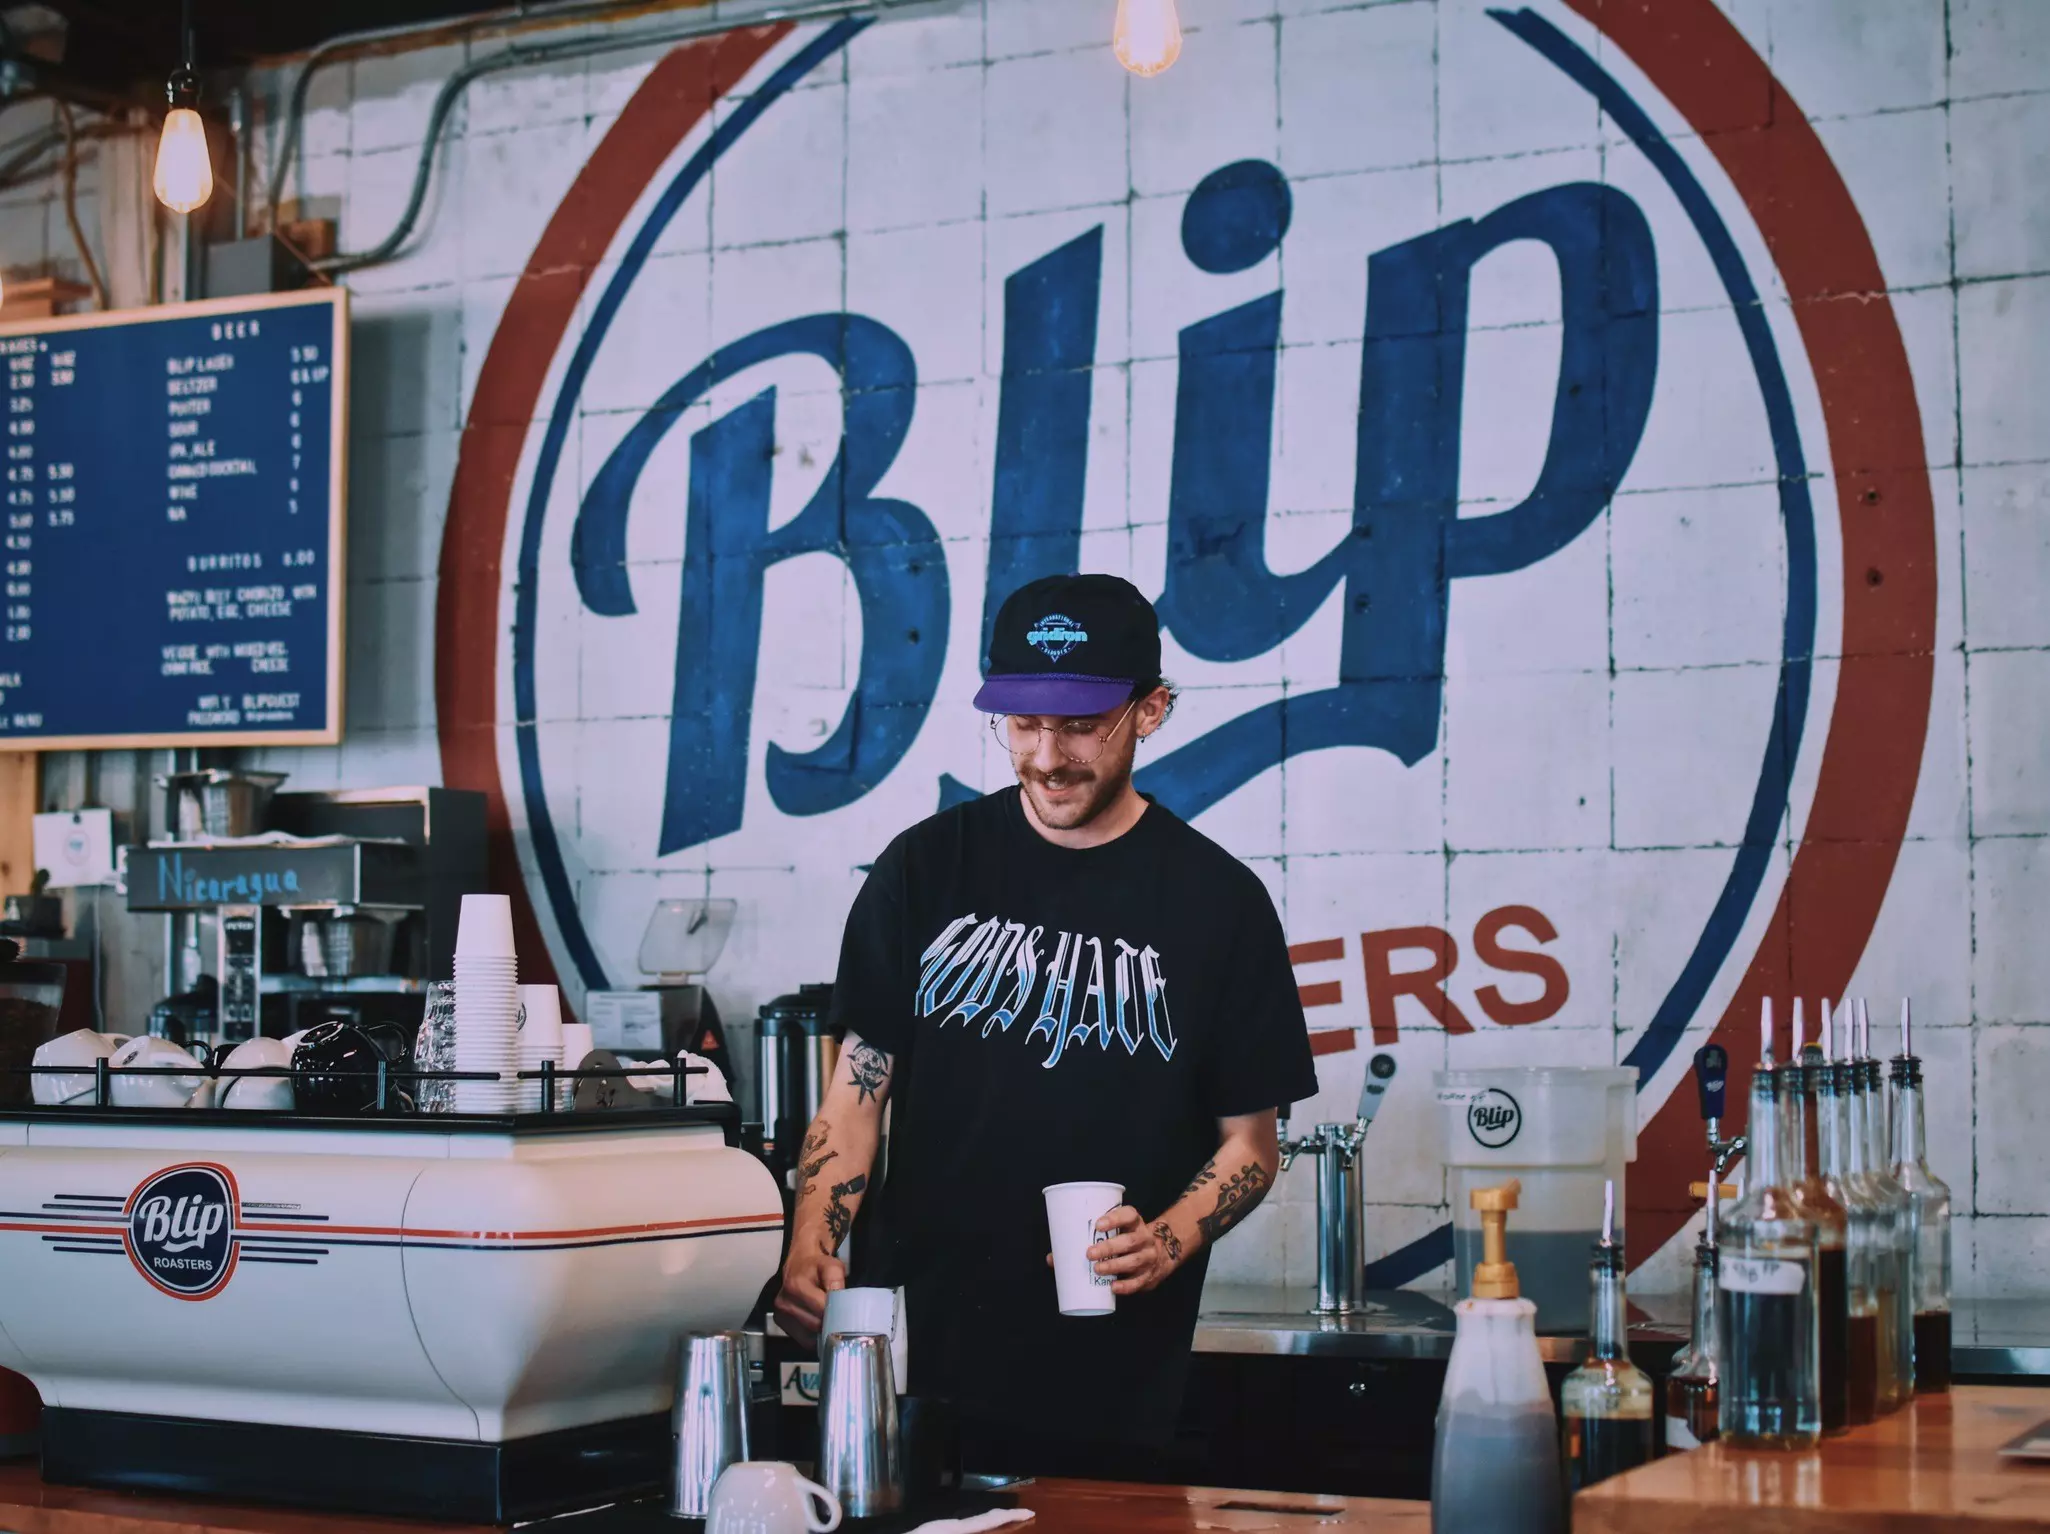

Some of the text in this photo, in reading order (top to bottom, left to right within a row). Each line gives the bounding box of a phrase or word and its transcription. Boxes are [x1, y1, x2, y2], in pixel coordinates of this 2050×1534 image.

[211, 320, 259, 341] BEER
[572, 158, 1660, 857] Blip
[188, 553, 262, 572] BURRITOS
[246, 601, 292, 617] CHEESE
[158, 852, 302, 903] Nicaragua
[1025, 931, 1177, 1068] HATE
[1473, 1105, 1515, 1131] Blip
[139, 1194, 224, 1253] Blip
[154, 1257, 213, 1271] ROASTERS
